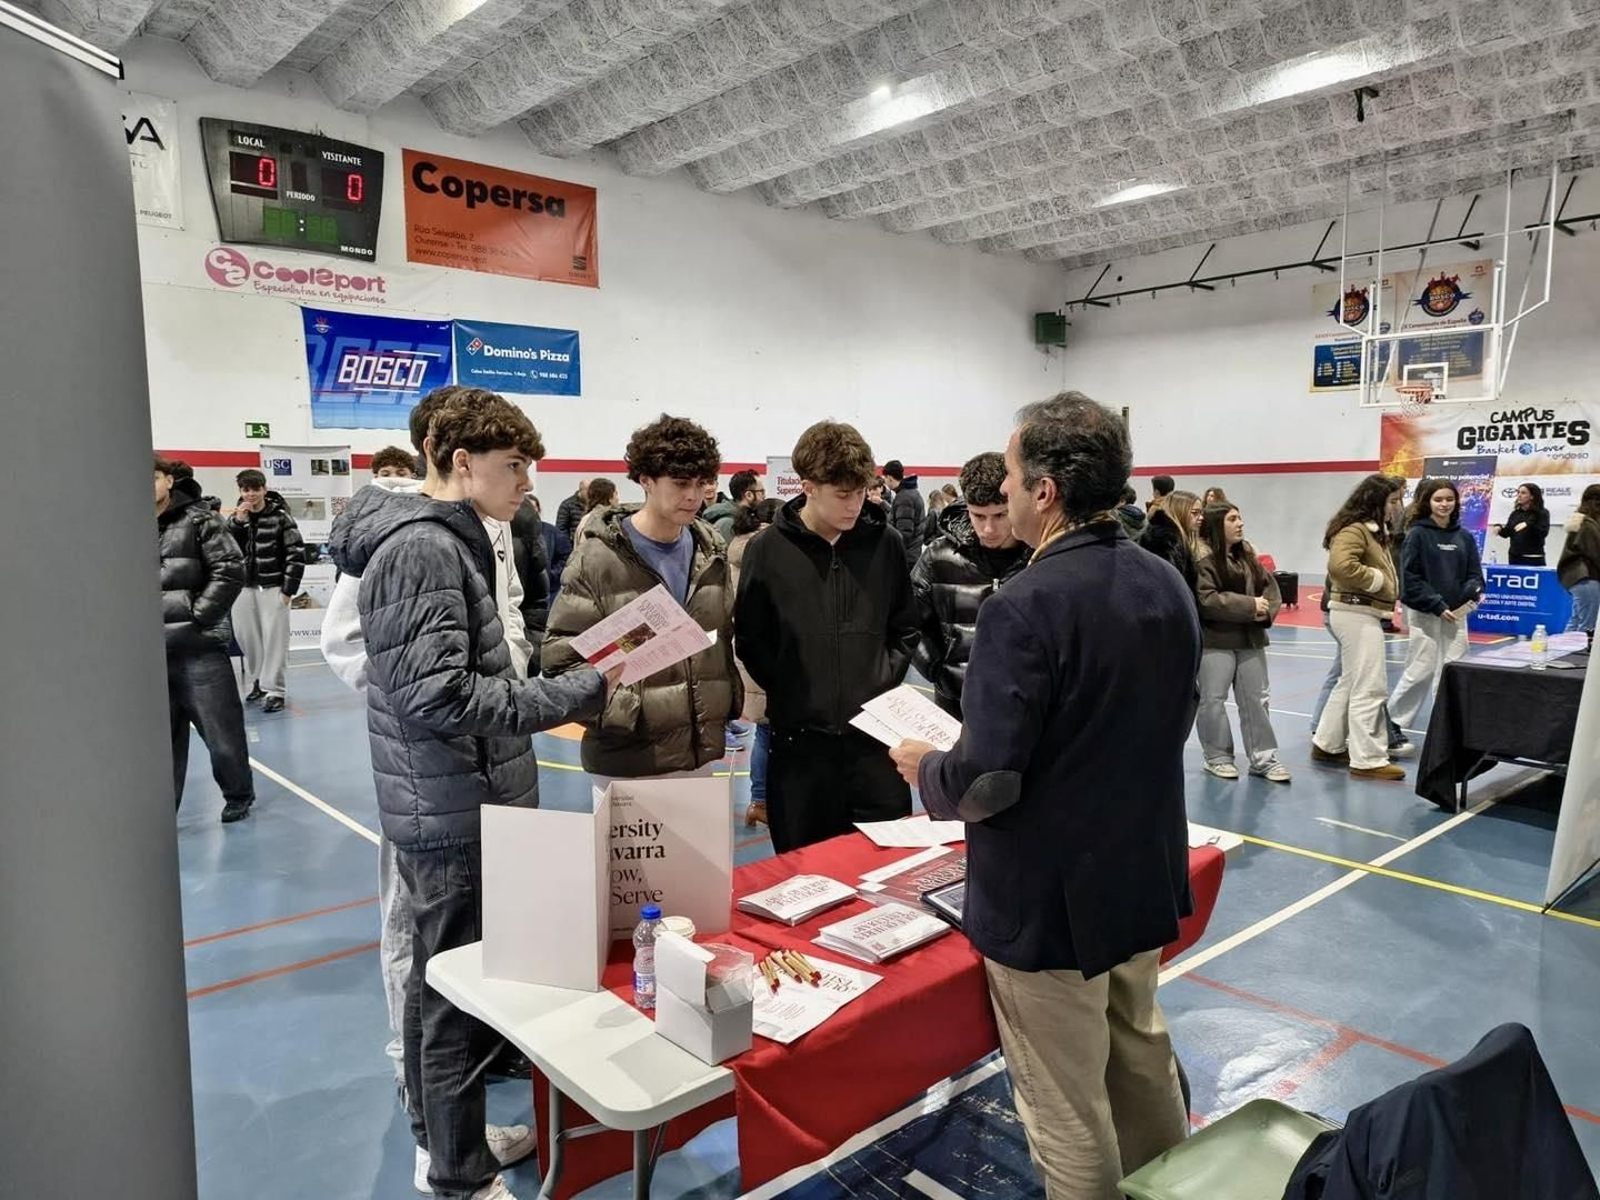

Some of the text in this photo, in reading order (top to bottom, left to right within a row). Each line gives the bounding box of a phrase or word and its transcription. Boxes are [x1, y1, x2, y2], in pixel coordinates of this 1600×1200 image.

[238, 135, 265, 149] LOCAL
[321, 150, 363, 167] VISITANTE
[258, 157, 276, 187] 0
[347, 173, 364, 201] 0
[412, 161, 566, 218] Copersa
[286, 190, 316, 202] PERIODO
[139, 209, 173, 220] PEUGEOT
[340, 244, 374, 256] MONDO
[253, 280, 317, 297] Especialistas
[332, 291, 387, 305] equipaciones
[484, 344, 570, 362] Domino's Pizza
[338, 354, 429, 388] BOSCO
[1490, 407, 1555, 424] CAMPUS
[1456, 420, 1591, 451] GIGANTES
[1477, 443, 1517, 455] Basket
[264, 459, 290, 470] USC
[1477, 613, 1520, 621] u-tad.com
[611, 886, 664, 906] Serve
